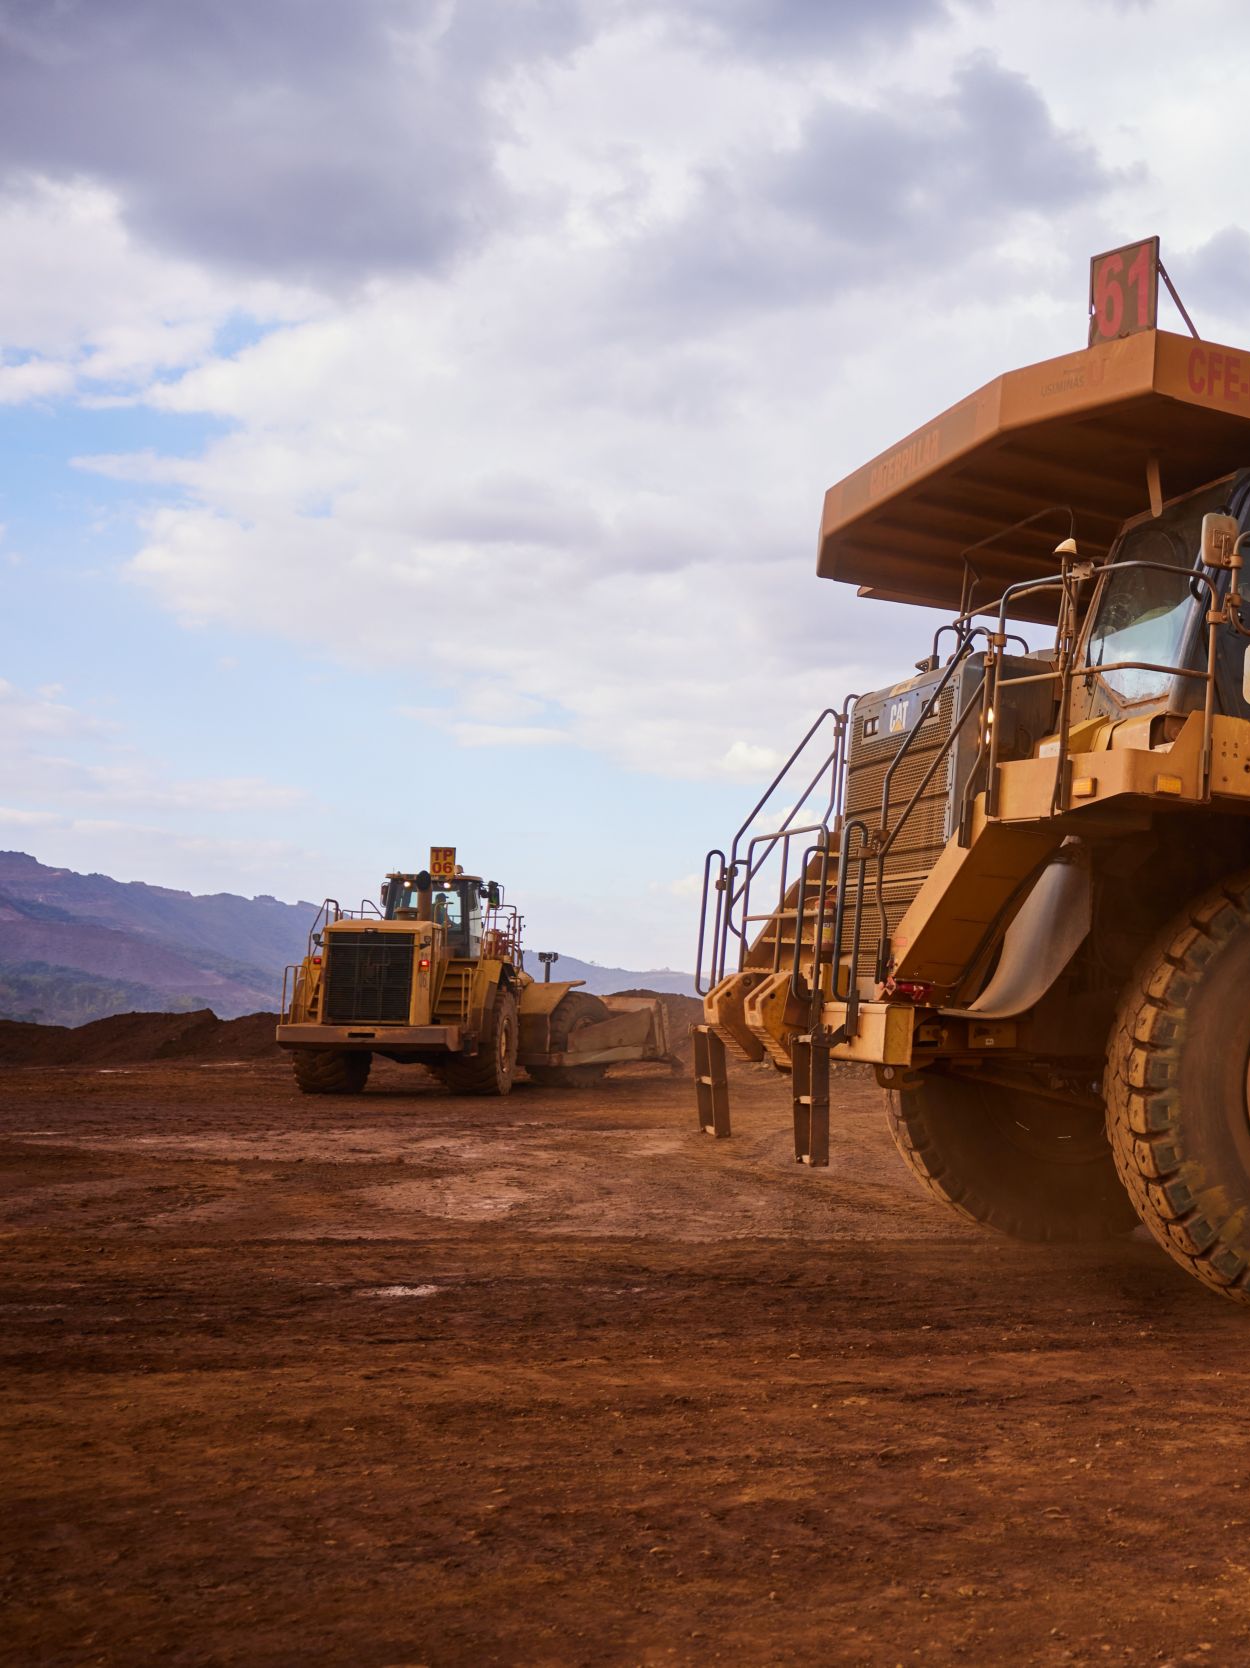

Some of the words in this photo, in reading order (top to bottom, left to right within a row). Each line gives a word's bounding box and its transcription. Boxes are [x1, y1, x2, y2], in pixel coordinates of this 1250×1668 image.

[1095, 243, 1151, 337] 61
[889, 701, 909, 733] CAT
[431, 848, 453, 861] TP
[432, 862, 453, 874] 06
